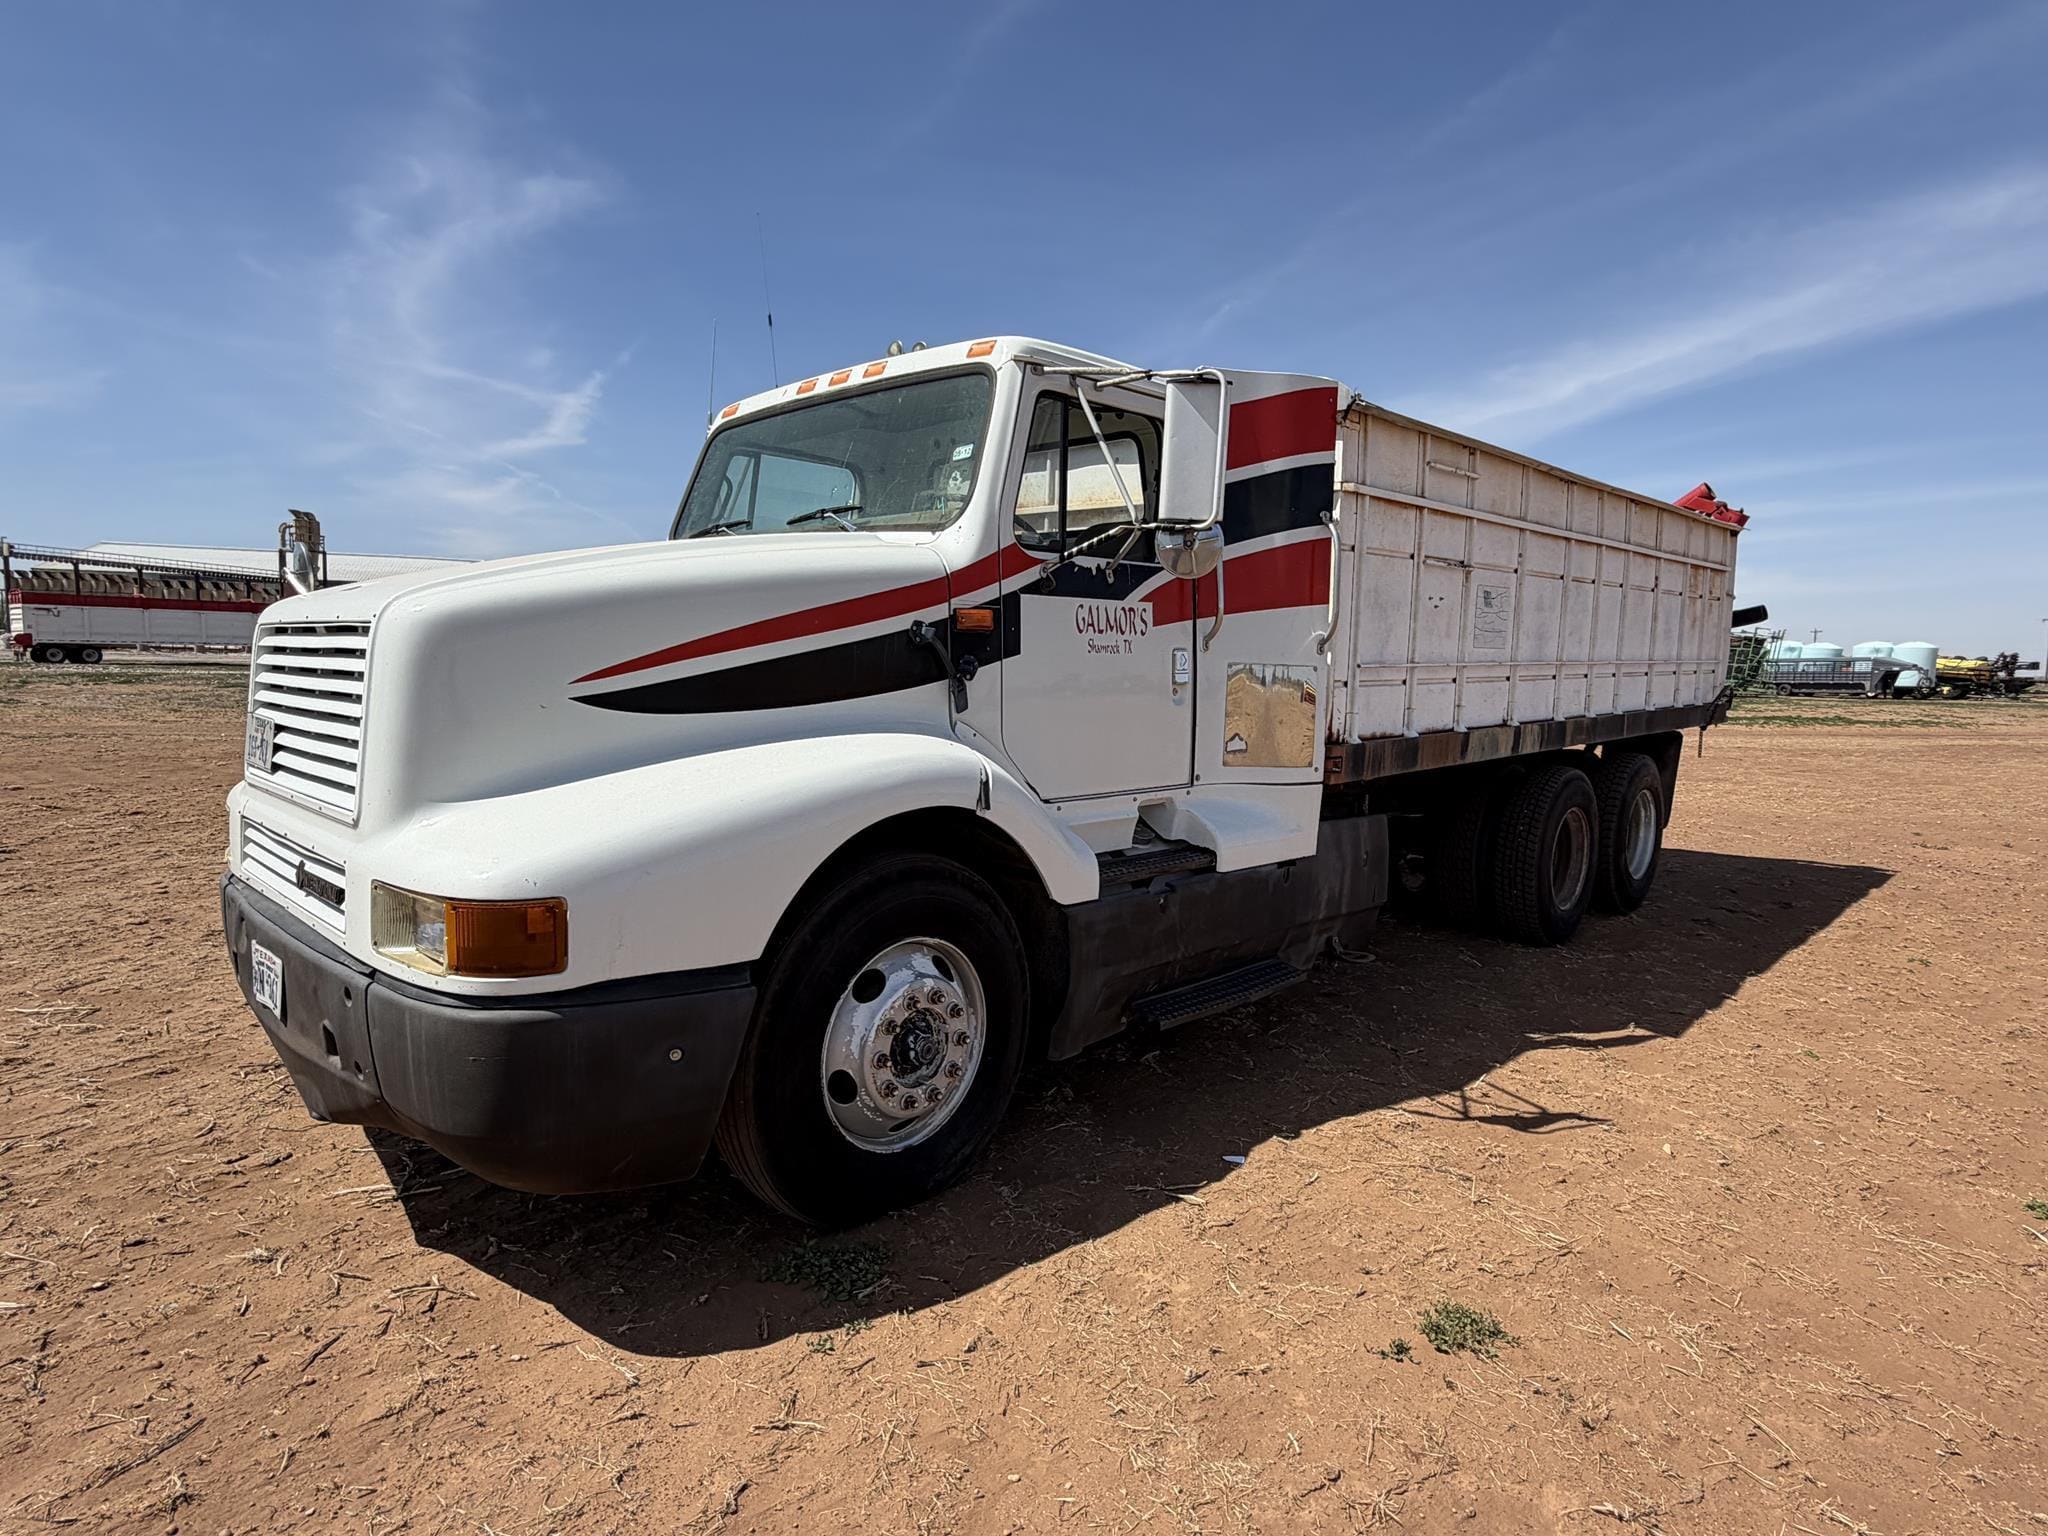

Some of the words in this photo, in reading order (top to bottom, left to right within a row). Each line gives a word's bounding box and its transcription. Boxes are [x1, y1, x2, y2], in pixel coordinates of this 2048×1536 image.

[1075, 603, 1148, 637] GALMOR'S
[1087, 638, 1121, 655] Shamrock
[1123, 639, 1133, 655] TX
